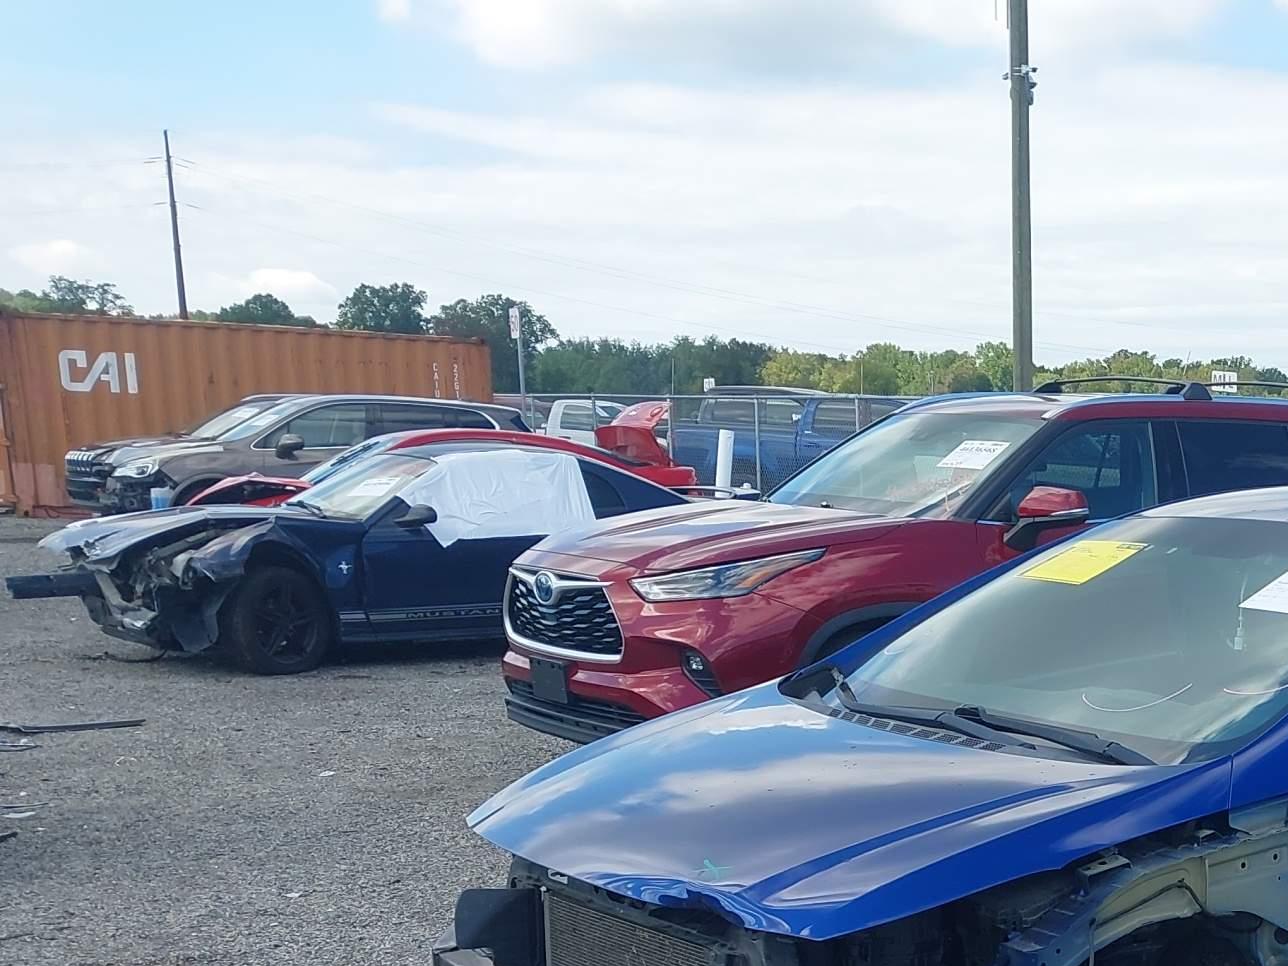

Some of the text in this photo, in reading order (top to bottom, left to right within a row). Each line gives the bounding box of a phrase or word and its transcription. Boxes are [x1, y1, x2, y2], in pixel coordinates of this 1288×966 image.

[58, 349, 139, 394] CAI
[432, 362, 441, 399] CAIU
[407, 608, 501, 619] MUSTAN
